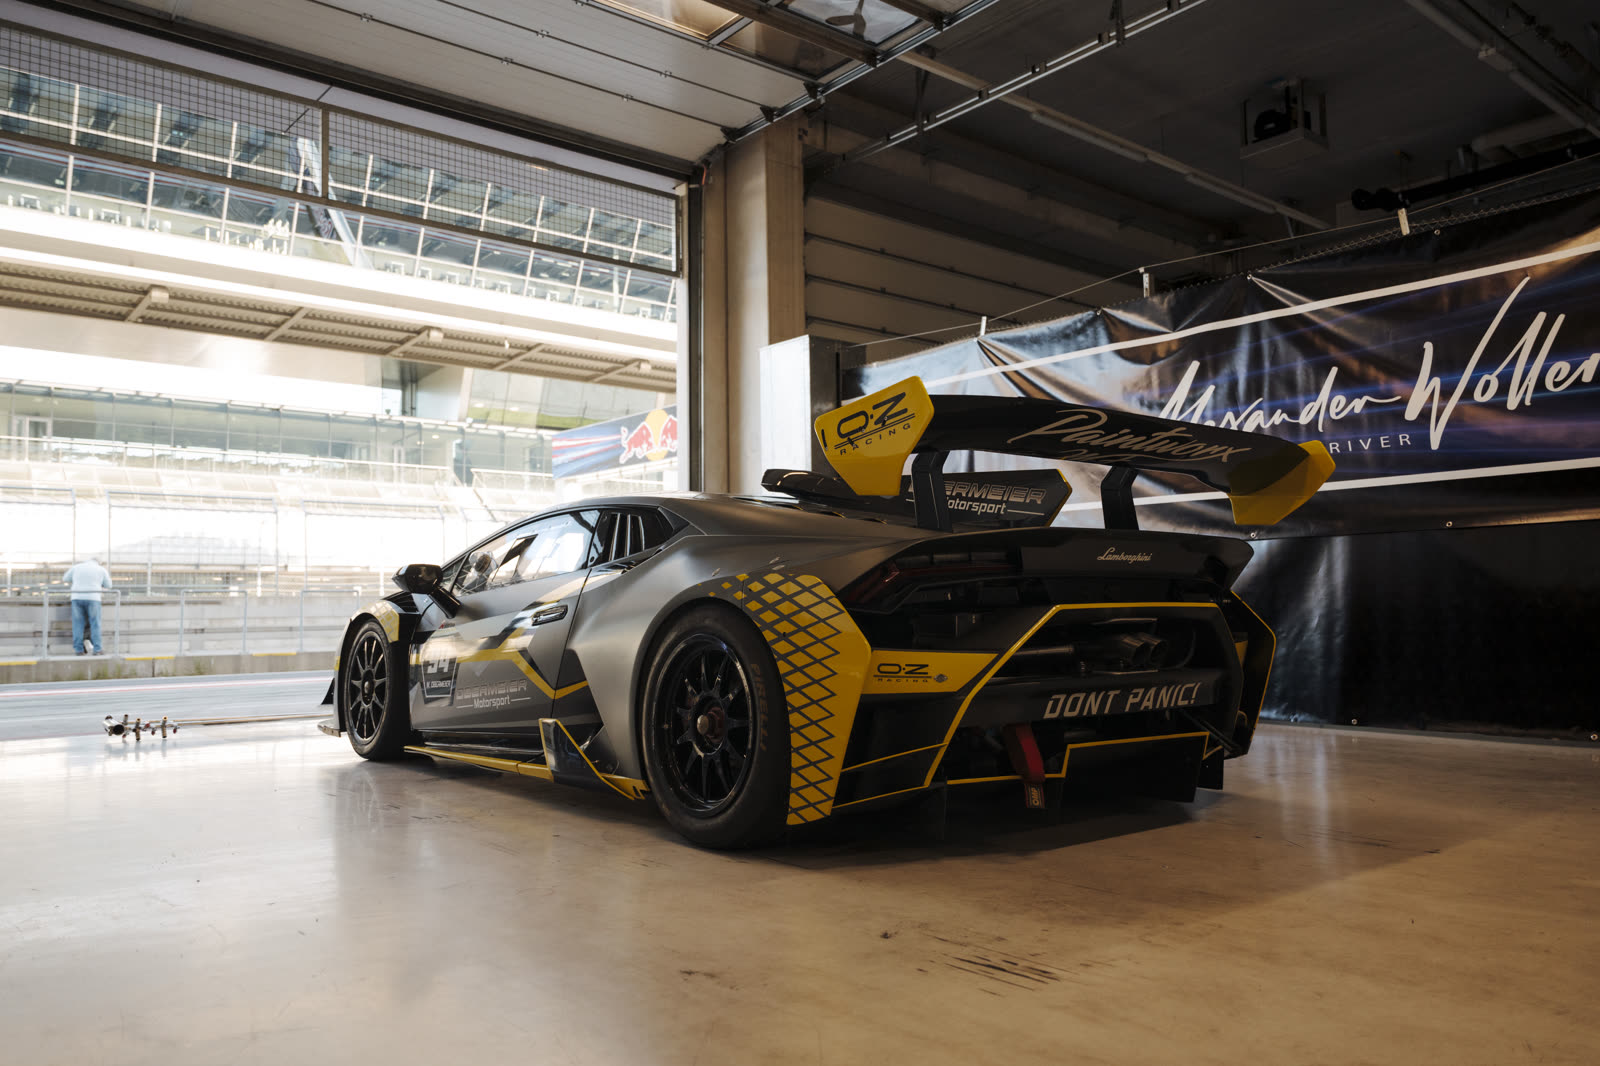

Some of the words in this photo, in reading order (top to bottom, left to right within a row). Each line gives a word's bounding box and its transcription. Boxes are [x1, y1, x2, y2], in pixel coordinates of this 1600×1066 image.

[1159, 360, 1401, 432] Alxander
[840, 423, 911, 455] RACING
[1330, 434, 1411, 454] RIVER
[907, 481, 1046, 504] ERMEIER
[946, 497, 1006, 515] otorsport
[1097, 547, 1152, 564] Lamborghini
[473, 694, 510, 709] Motorsport
[1043, 689, 1120, 719] DONT
[1125, 682, 1202, 712] PANIC!
